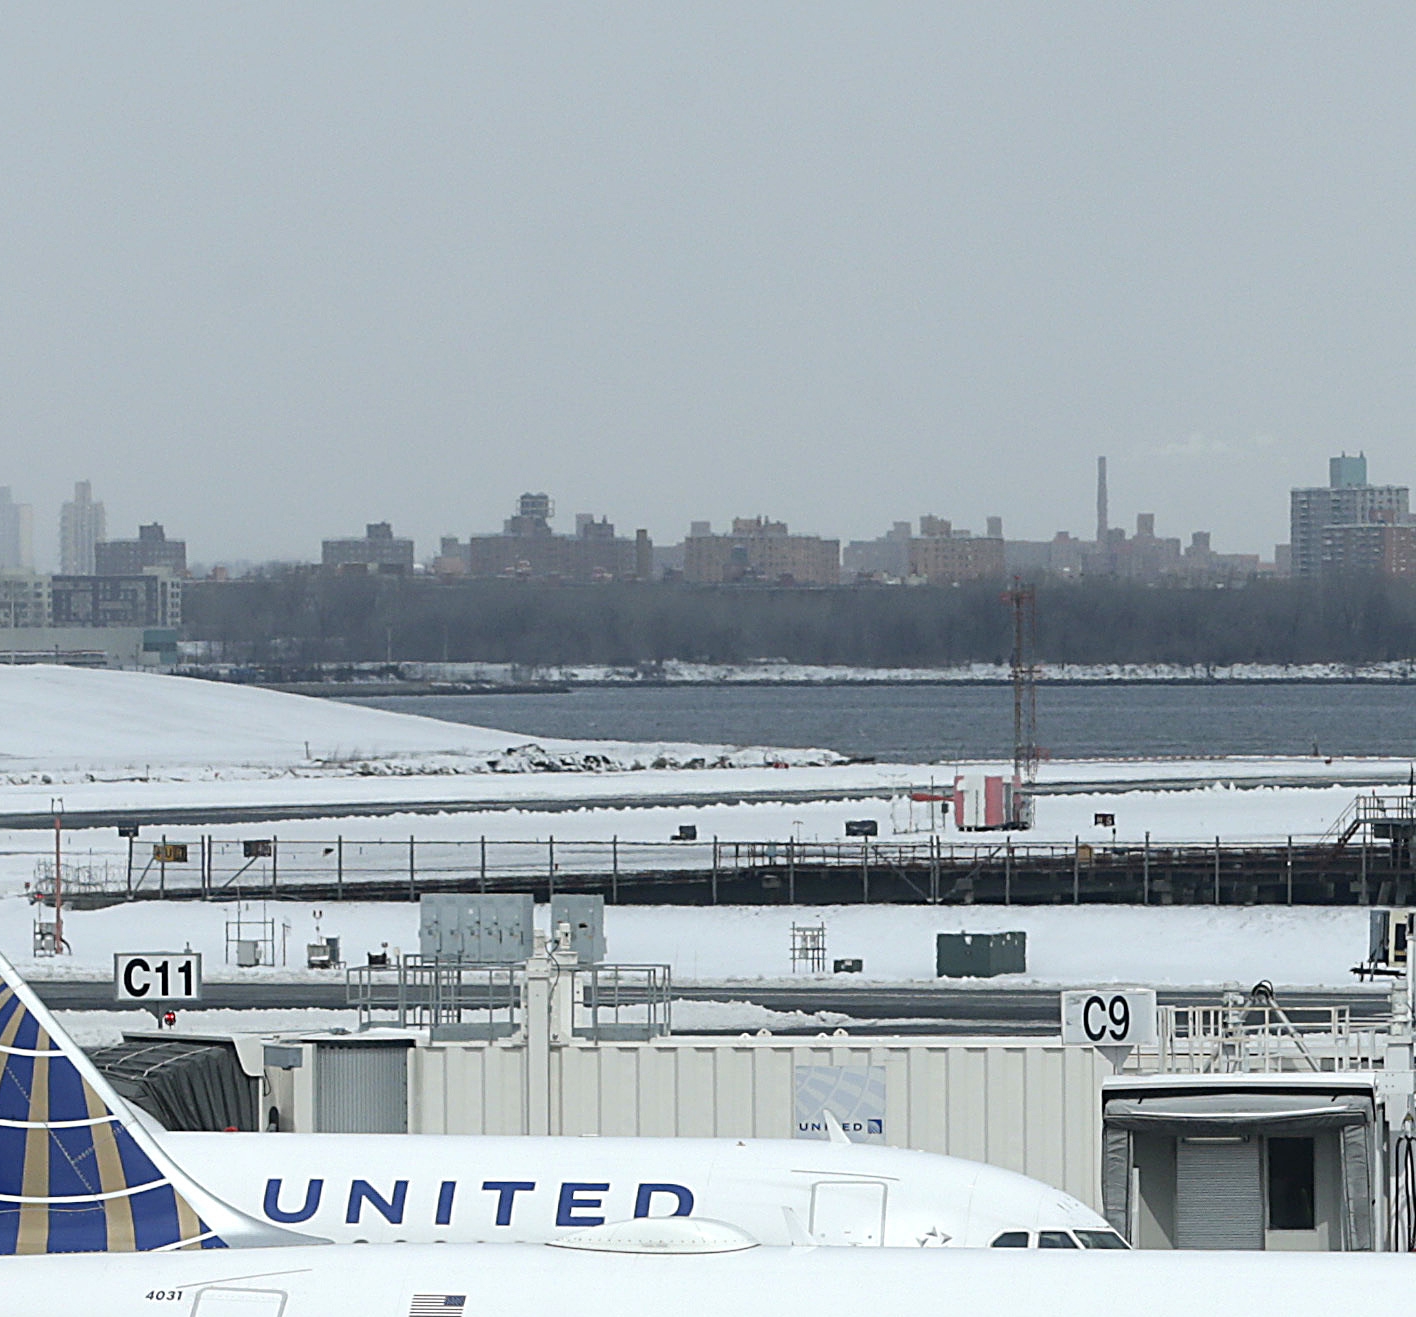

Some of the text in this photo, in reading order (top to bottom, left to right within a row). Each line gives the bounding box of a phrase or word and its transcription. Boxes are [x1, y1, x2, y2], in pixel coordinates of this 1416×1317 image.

[124, 958, 192, 997] C11
[1083, 995, 1130, 1042] C9
[799, 1122, 863, 1132] UNIED
[263, 1178, 695, 1228] UNITED
[145, 1290, 183, 1301] 4031
